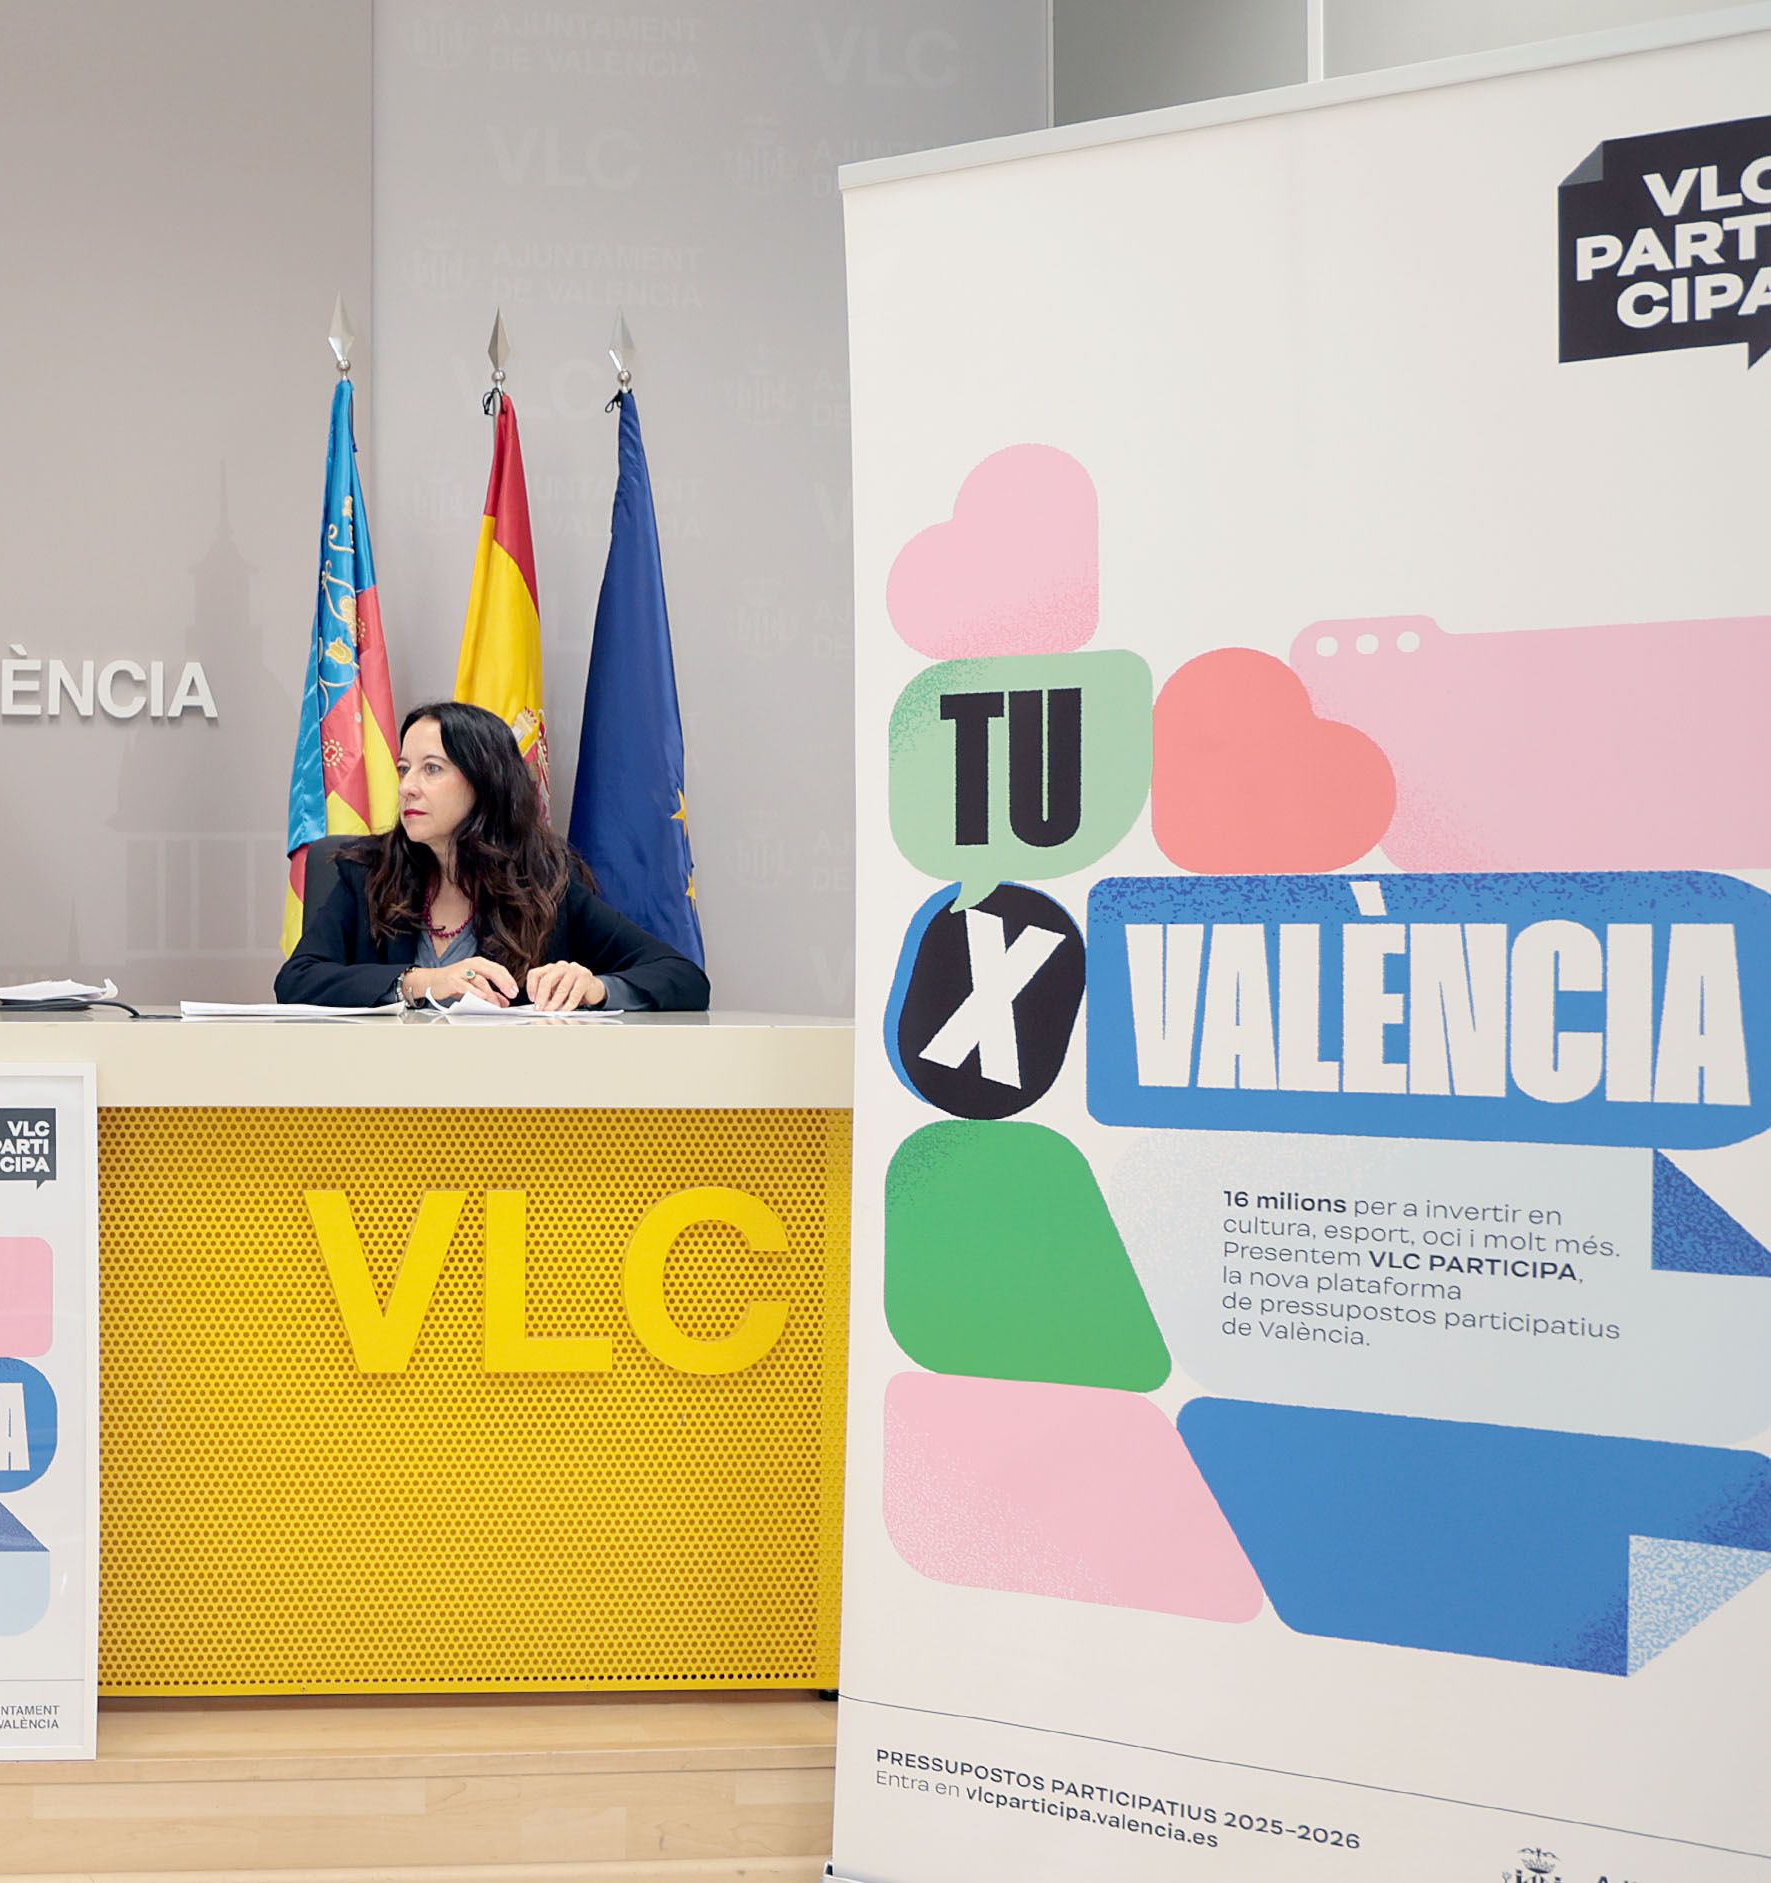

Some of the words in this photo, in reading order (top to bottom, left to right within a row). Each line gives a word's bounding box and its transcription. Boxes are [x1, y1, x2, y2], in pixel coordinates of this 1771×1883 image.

[809, 23, 960, 89] VLC
[486, 124, 641, 190] VLC
[1642, 155, 1771, 217] VLC
[1617, 267, 1771, 328] CIPA
[939, 687, 1083, 848] TU
[918, 906, 1068, 1090] X
[1124, 880, 1753, 1108] VALÈNCIA
[7, 1120, 51, 1137] VLC
[0, 1156, 51, 1173] CIPA
[1223, 1190, 1249, 1208] 16
[1257, 1192, 1347, 1214] milions
[1354, 1198, 1396, 1219] per
[1403, 1201, 1418, 1217] a
[1426, 1199, 1522, 1224] invertir
[1528, 1207, 1562, 1226] en
[1223, 1215, 1317, 1241] cultura,
[1324, 1223, 1415, 1246] esport,
[1423, 1228, 1461, 1248] oci
[1469, 1229, 1475, 1248] i
[1483, 1231, 1546, 1252] molt
[1555, 1235, 1621, 1257] més.
[304, 1186, 791, 1375] VLC
[1222, 1266, 1243, 1284] la
[1249, 1270, 1309, 1289] nova
[1316, 1272, 1461, 1300] plataforma
[1224, 1241, 1361, 1267] Presentem
[1368, 1250, 1421, 1270] VLC
[1429, 1255, 1583, 1284] PARTICIPA,
[1222, 1292, 1253, 1311] de
[1260, 1296, 1437, 1325] pressupostos
[1444, 1310, 1621, 1340] participatius
[1222, 1318, 1253, 1337] de
[1258, 1321, 1371, 1347] València.
[876, 1749, 1046, 1791] PRESSUPOSTOS
[1050, 1778, 1218, 1824] PARTICIPATIUS
[1223, 1812, 1361, 1850] 2025-2026
[876, 1769, 930, 1793] Entra
[935, 1782, 960, 1798] en
[966, 1785, 1219, 1849] vlcparticipa.valencia.es
